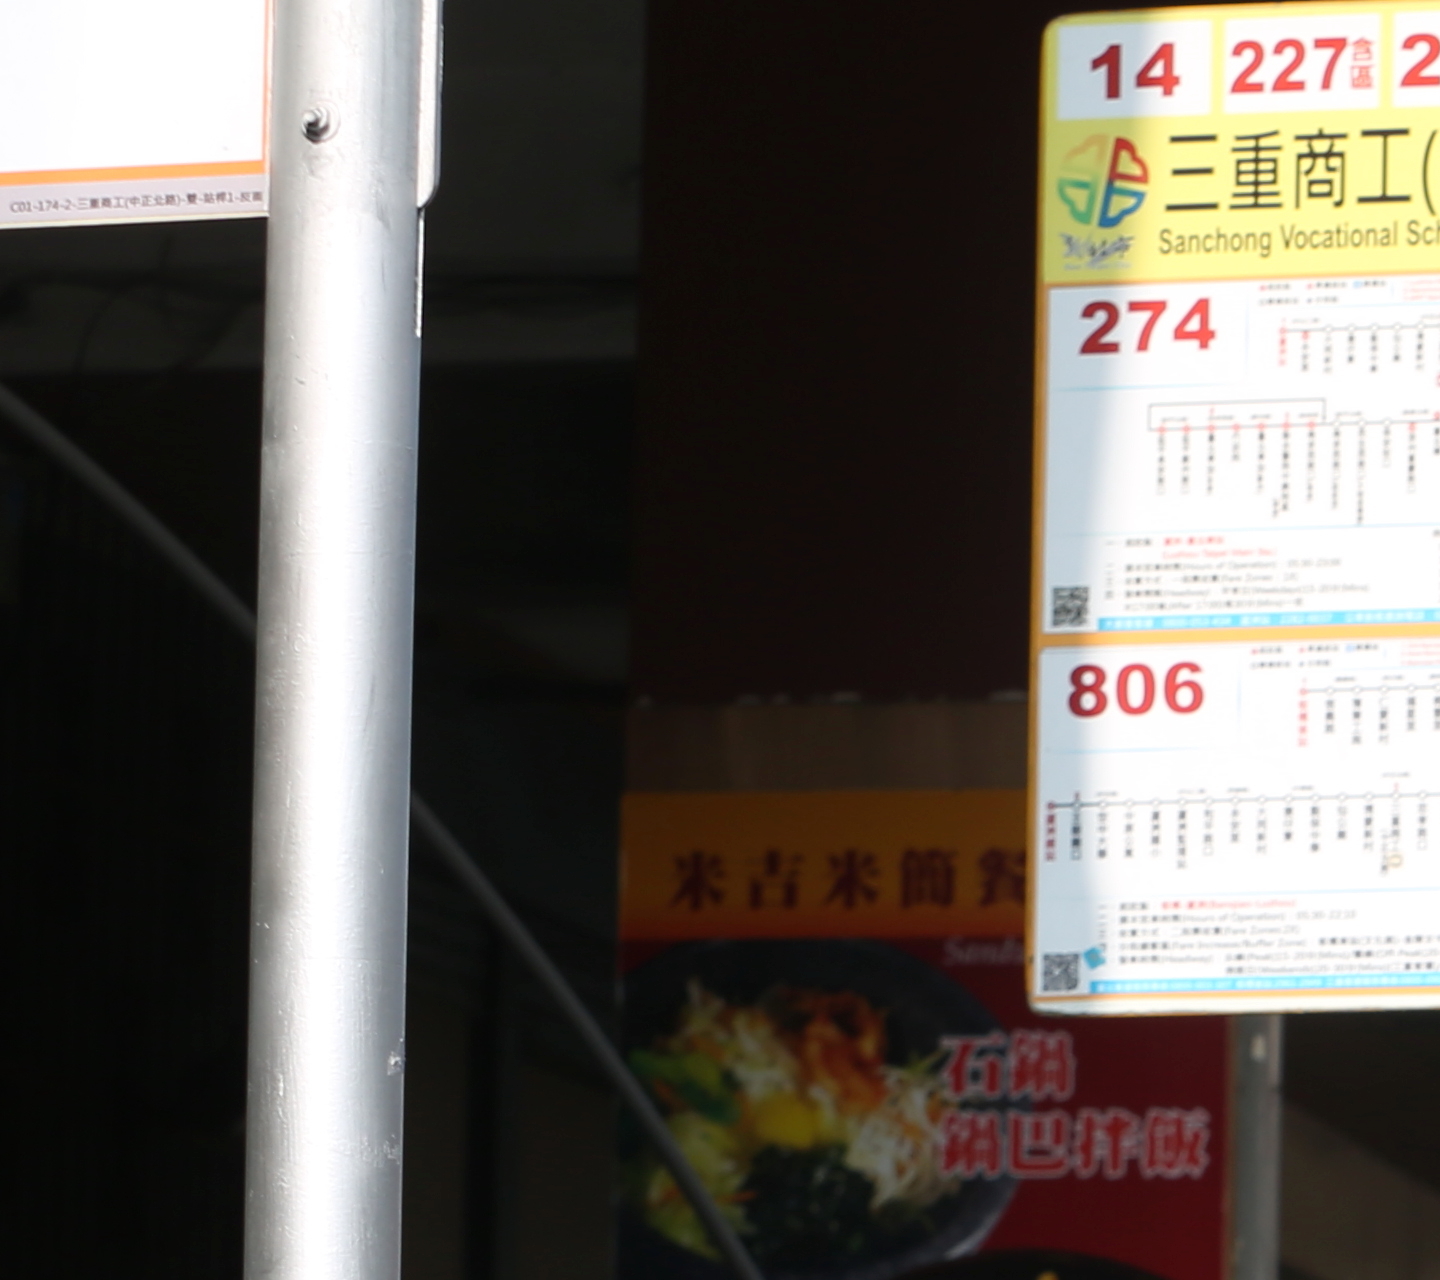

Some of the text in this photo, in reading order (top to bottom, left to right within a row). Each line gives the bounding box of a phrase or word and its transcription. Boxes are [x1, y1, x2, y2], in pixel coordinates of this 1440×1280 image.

[1088, 42, 1181, 101] 14
[1230, 37, 1348, 94] 227
[1158, 226, 1274, 260] Sanchong
[1279, 221, 1400, 251] Vocational
[1078, 298, 1217, 356] 274
[1067, 661, 1205, 719] 806
[940, 1031, 1076, 1102] 石鍋
[937, 1108, 1211, 1182] 鍋巴拌飯
